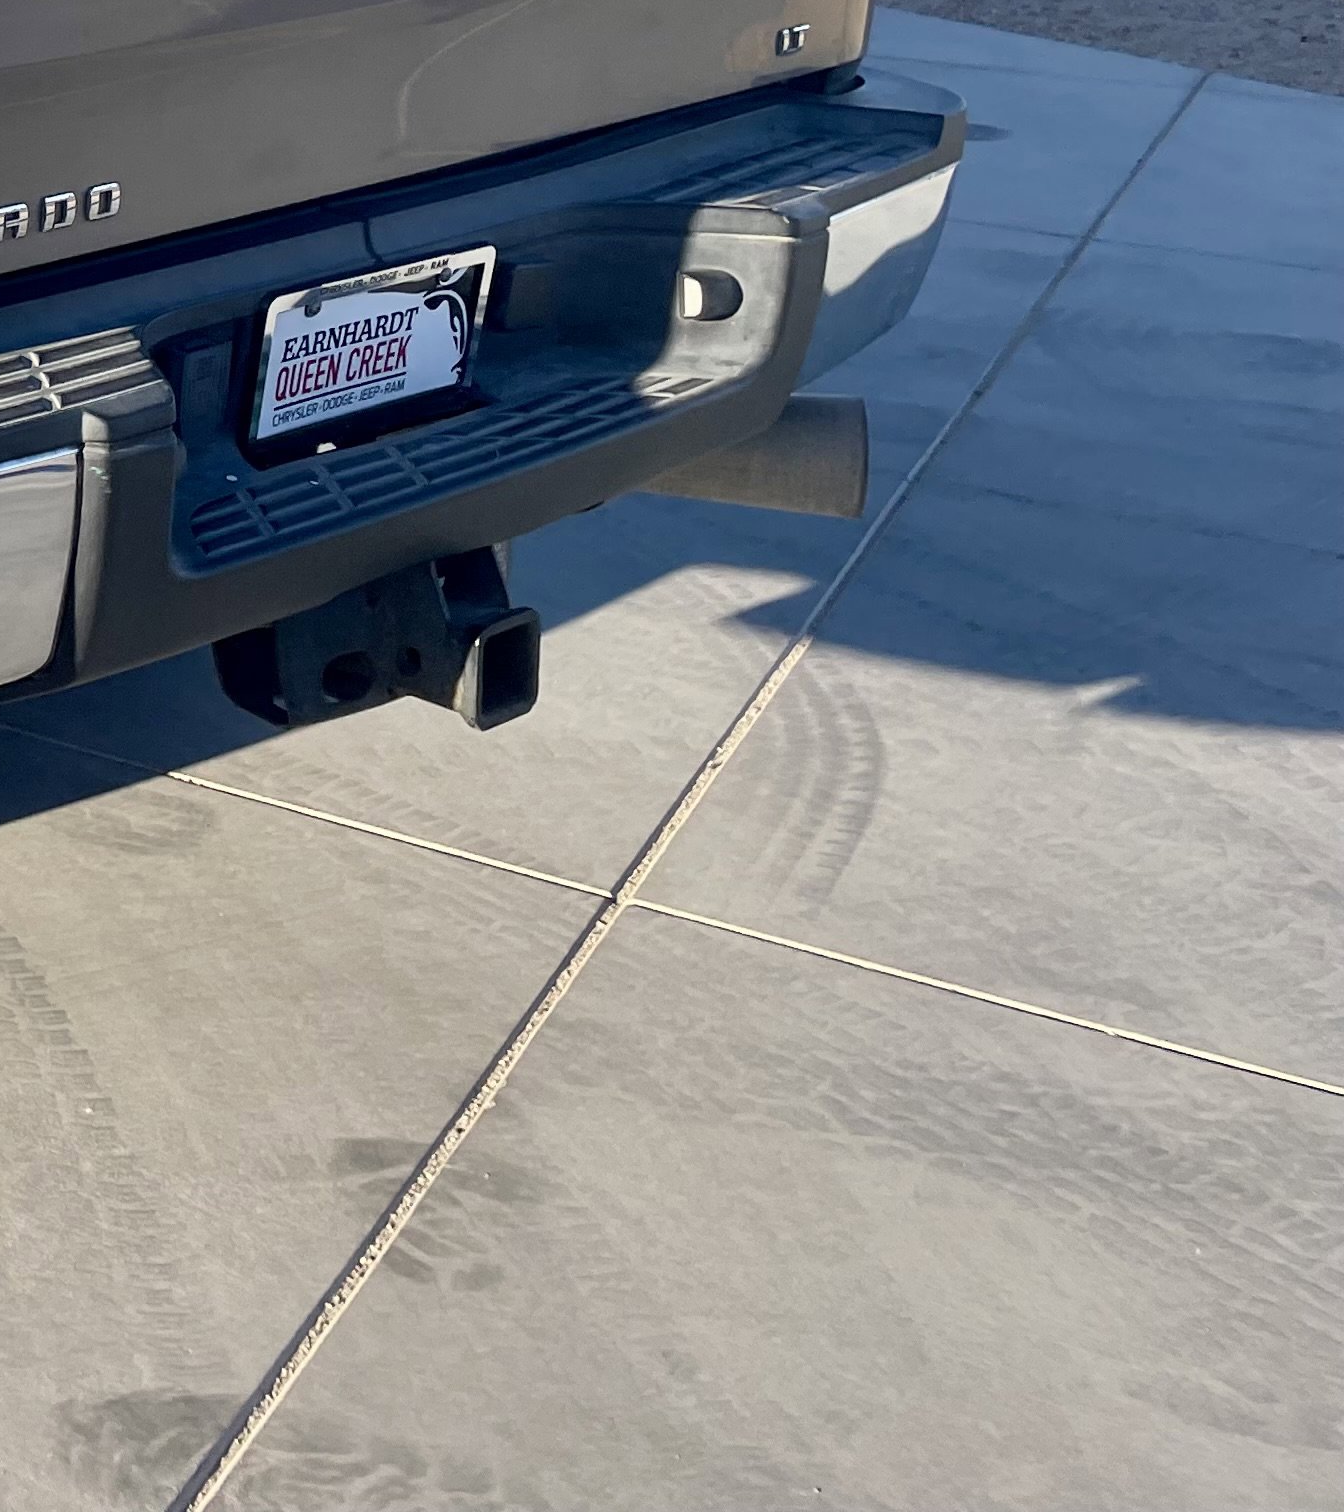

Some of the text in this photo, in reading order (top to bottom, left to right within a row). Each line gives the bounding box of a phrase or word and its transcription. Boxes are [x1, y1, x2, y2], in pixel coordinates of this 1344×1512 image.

[782, 24, 811, 53] LT
[430, 258, 449, 270] RAM
[281, 307, 420, 363] EARNHARDT
[275, 352, 343, 402] QUEEN
[346, 334, 413, 382] CREEK
[273, 379, 405, 426] CHRYSLER DODGE JEEP RAM
